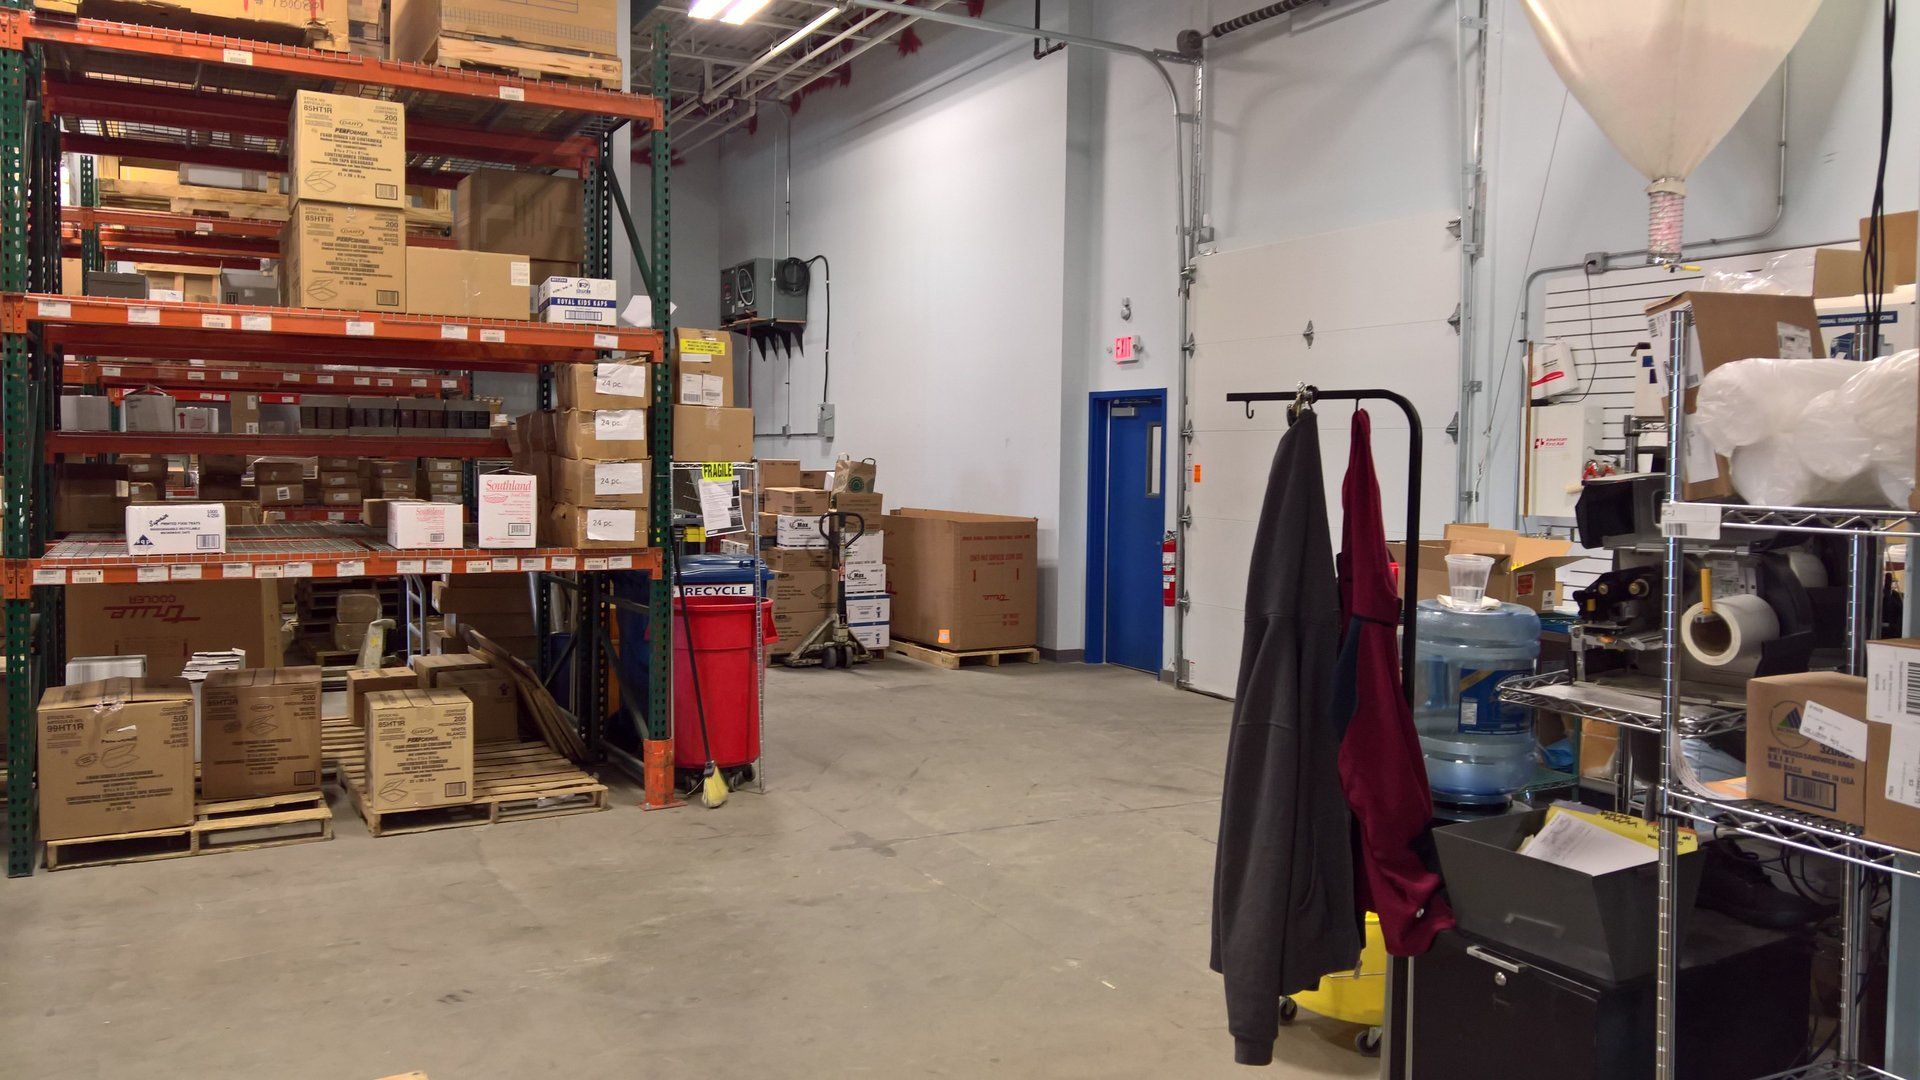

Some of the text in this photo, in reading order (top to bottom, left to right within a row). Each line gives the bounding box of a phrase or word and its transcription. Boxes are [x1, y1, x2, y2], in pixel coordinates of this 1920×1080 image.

[1116, 336, 1131, 358] EXIT
[703, 463, 732, 478] FRAGILE
[486, 480, 531, 491] Southland
[685, 586, 747, 596] RECYCLE
[129, 594, 176, 604] COOLER
[47, 724, 84, 732] 99HT1R
